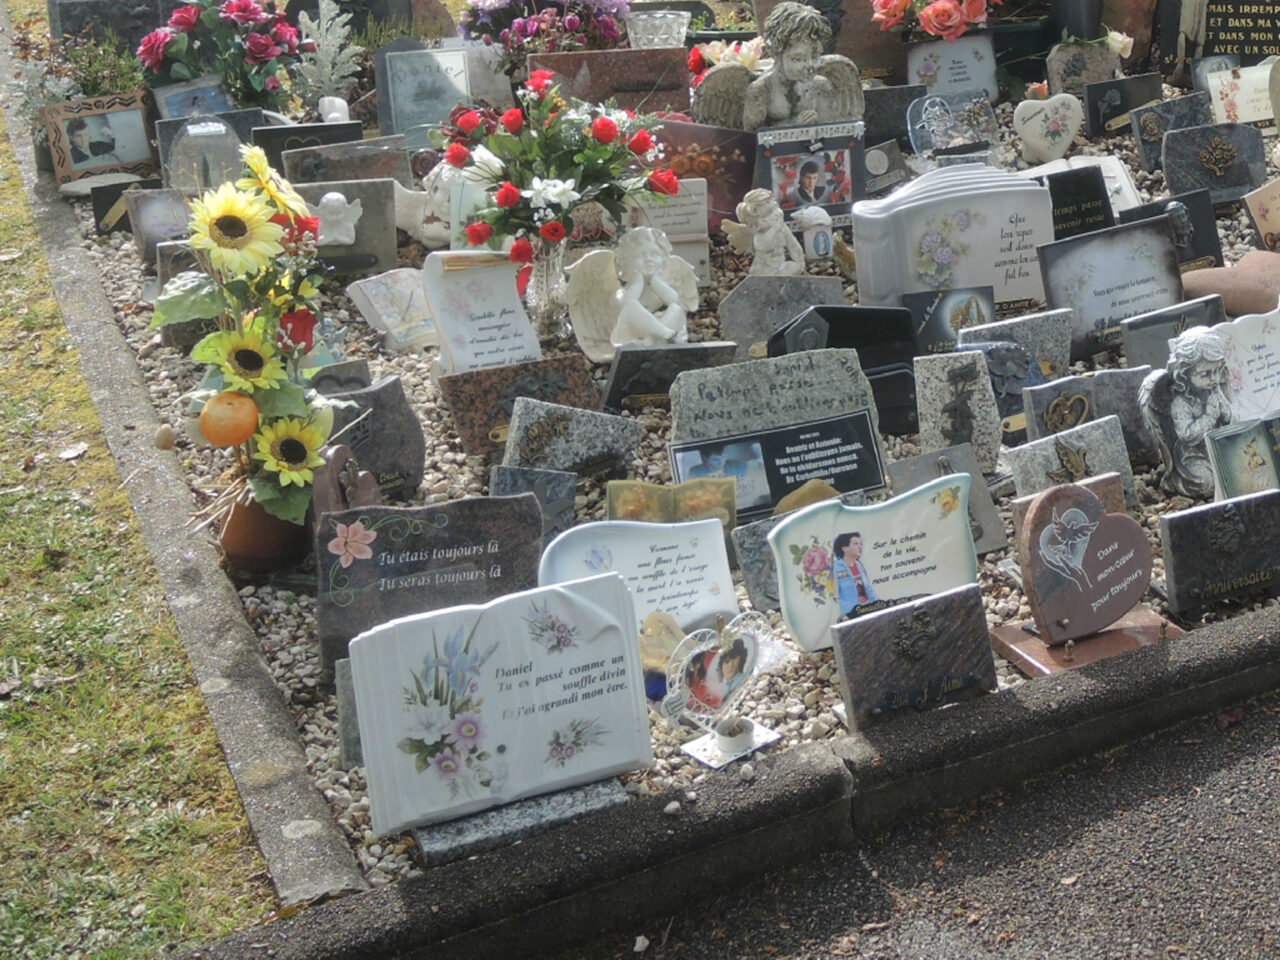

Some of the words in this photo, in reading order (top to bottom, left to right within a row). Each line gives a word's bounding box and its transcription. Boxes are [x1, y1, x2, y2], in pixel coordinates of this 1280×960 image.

[1208, 4, 1233, 14] MAIS
[1209, 18, 1222, 27] ET
[1228, 18, 1253, 28] DANS
[1257, 18, 1271, 28] MA
[1219, 32, 1244, 40] DANS
[1251, 32, 1273, 41] MON
[1213, 44, 1239, 54] AVEC
[1245, 45, 1259, 54] UN
[1054, 206, 1077, 216] temps
[1055, 217, 1081, 230] ouvenir
[900, 531, 926, 543] chemin
[378, 551, 395, 565] Tu
[399, 550, 428, 563] étais
[432, 544, 484, 562] toujours
[487, 540, 500, 553] là
[1097, 542, 1119, 560] Dans
[880, 564, 892, 572] ton
[895, 554, 926, 568] souvenir
[378, 578, 395, 591] Tu
[399, 575, 431, 588] seras
[435, 569, 486, 586] toujours
[490, 564, 501, 578] là
[872, 576, 889, 584] nous
[892, 565, 937, 580] accompagne
[1097, 566, 1115, 581] mon
[1091, 592, 1109, 612] pour
[1110, 569, 1142, 595] toujours
[495, 661, 533, 678] Daniel
[518, 680, 529, 688] es
[535, 669, 563, 687] passé
[569, 660, 605, 676] comme
[611, 655, 624, 664] un
[562, 675, 597, 691] souffle
[600, 668, 626, 682] divin
[538, 692, 578, 712] agrandi
[582, 688, 604, 700] mon
